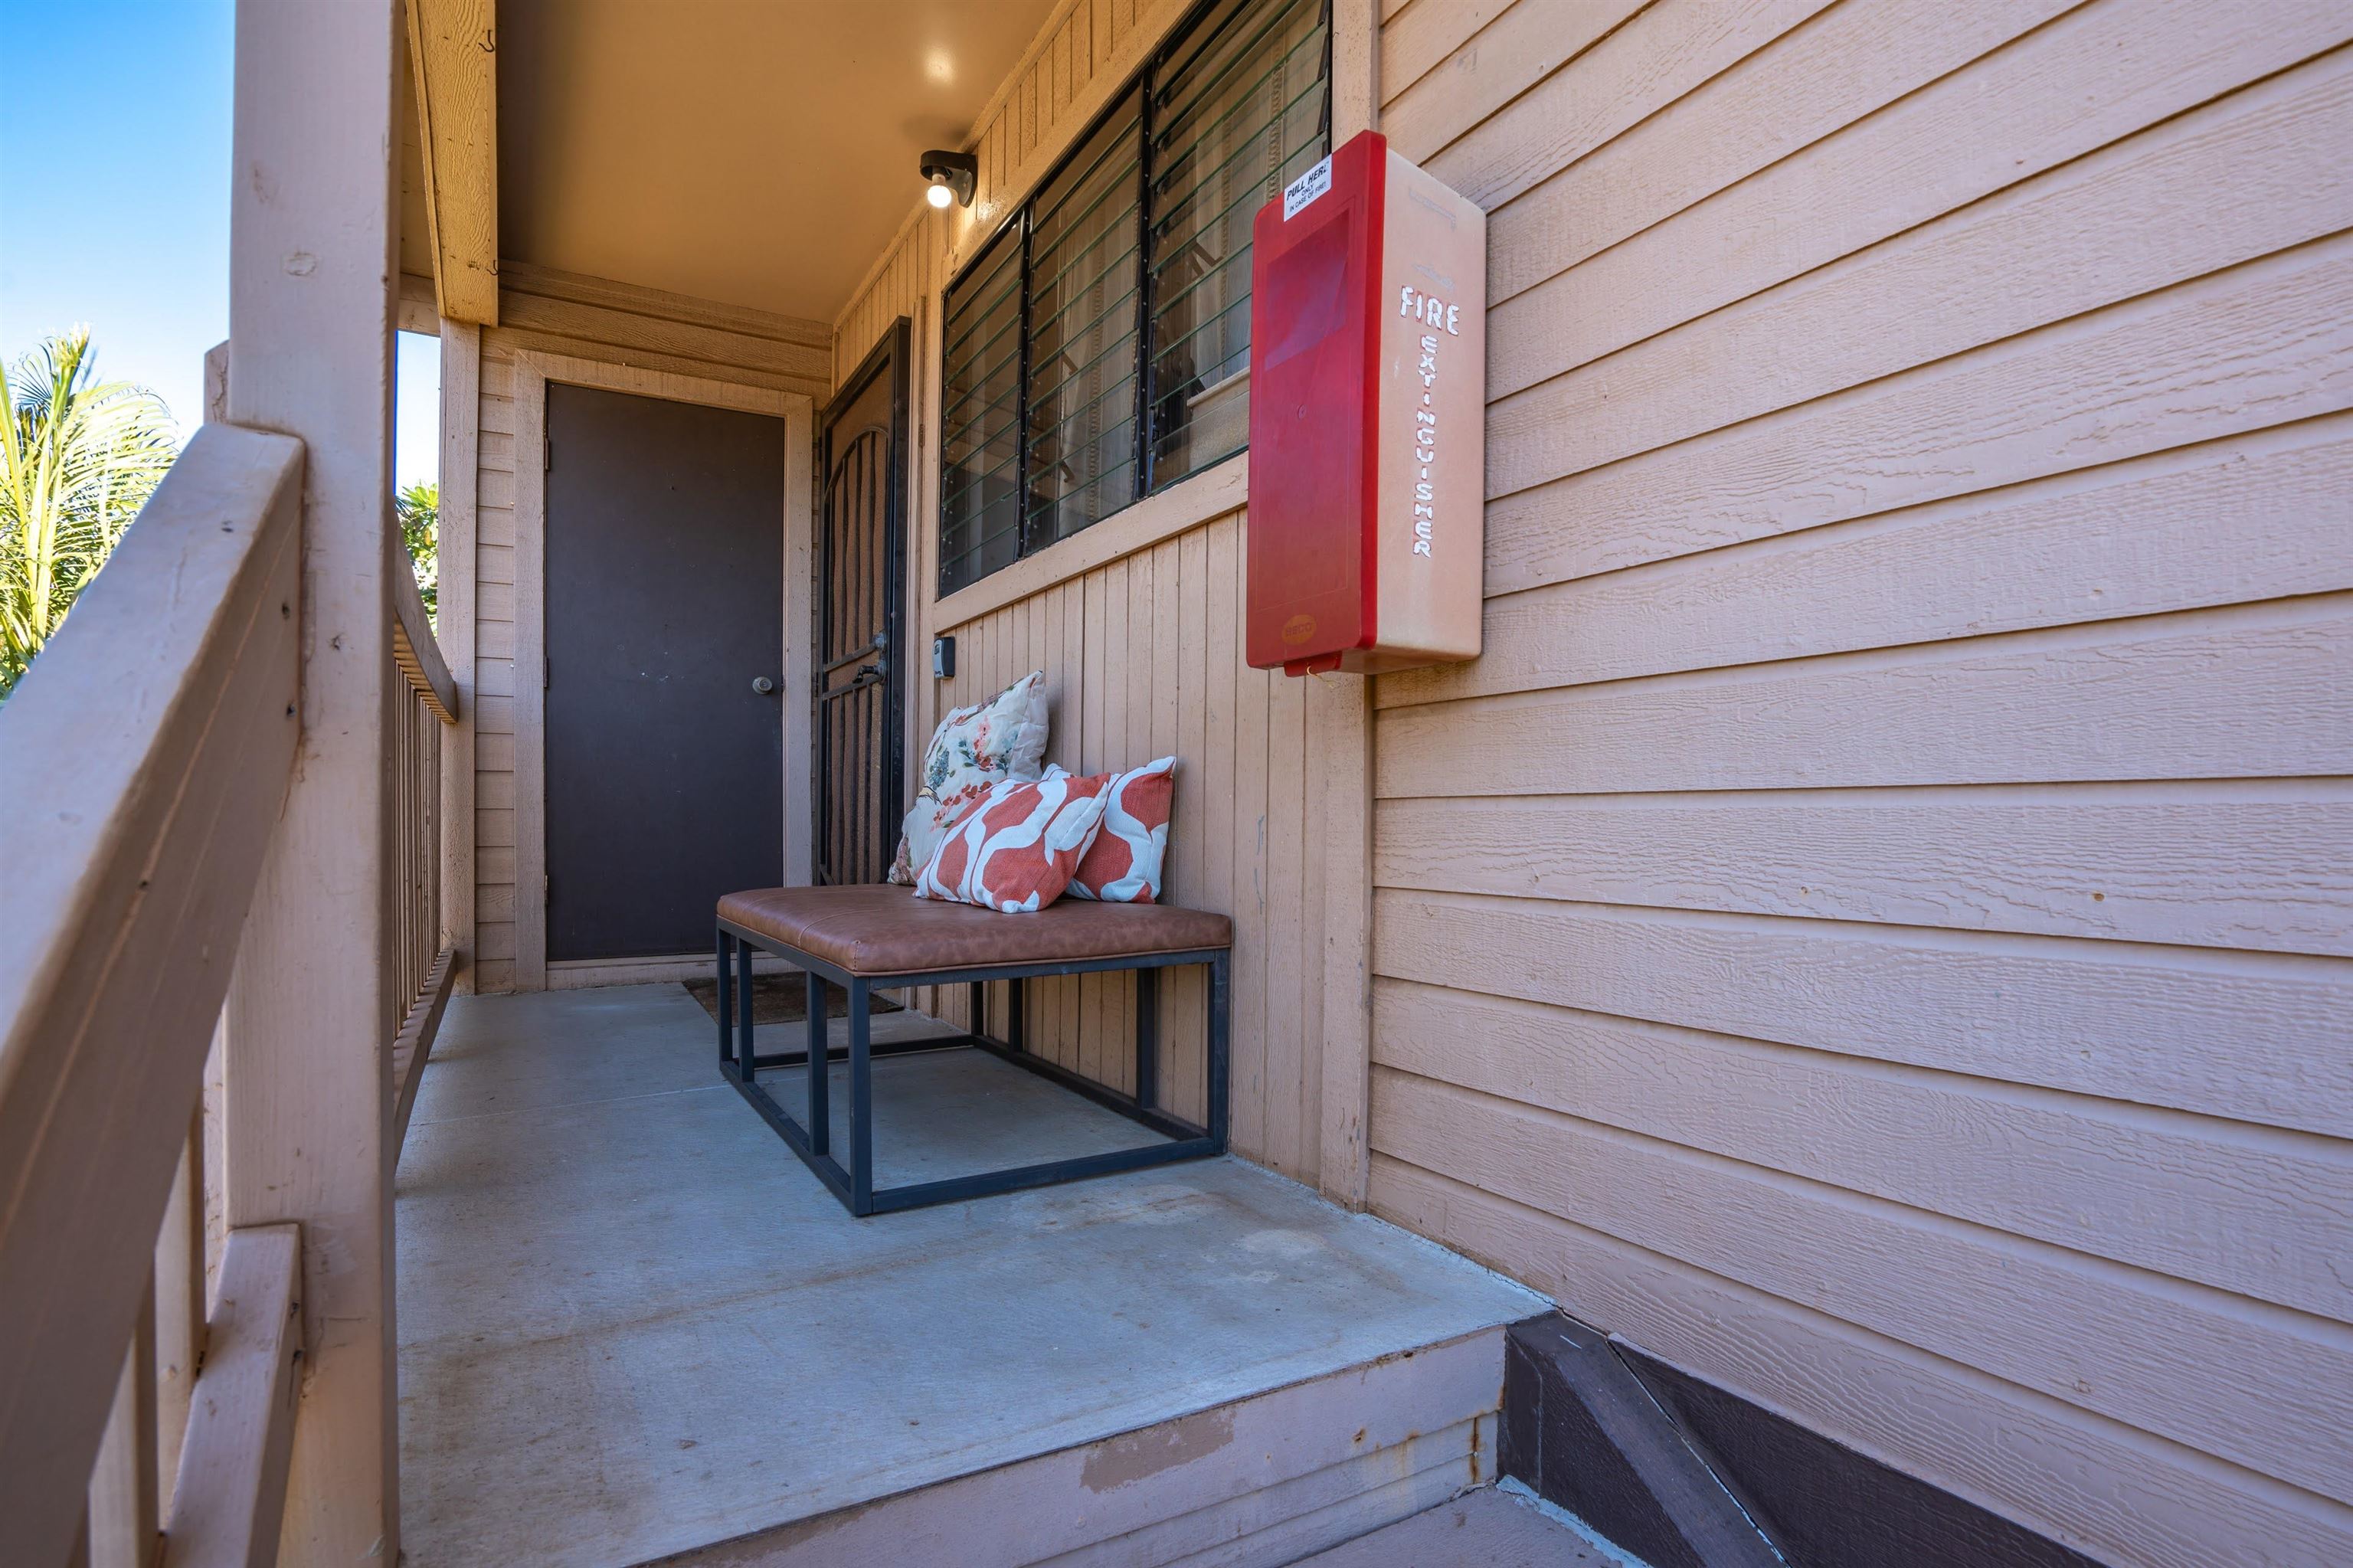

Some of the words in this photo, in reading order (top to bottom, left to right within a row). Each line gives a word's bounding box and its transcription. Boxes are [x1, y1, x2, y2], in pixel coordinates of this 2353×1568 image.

[1287, 181, 1305, 201] PULL
[1295, 195, 1307, 208] CASE
[1307, 189, 1314, 198] OF
[1301, 183, 1314, 196] ONLY
[1400, 285, 1459, 336] FIRE
[1412, 334, 1438, 558] EXTINGUISHER
